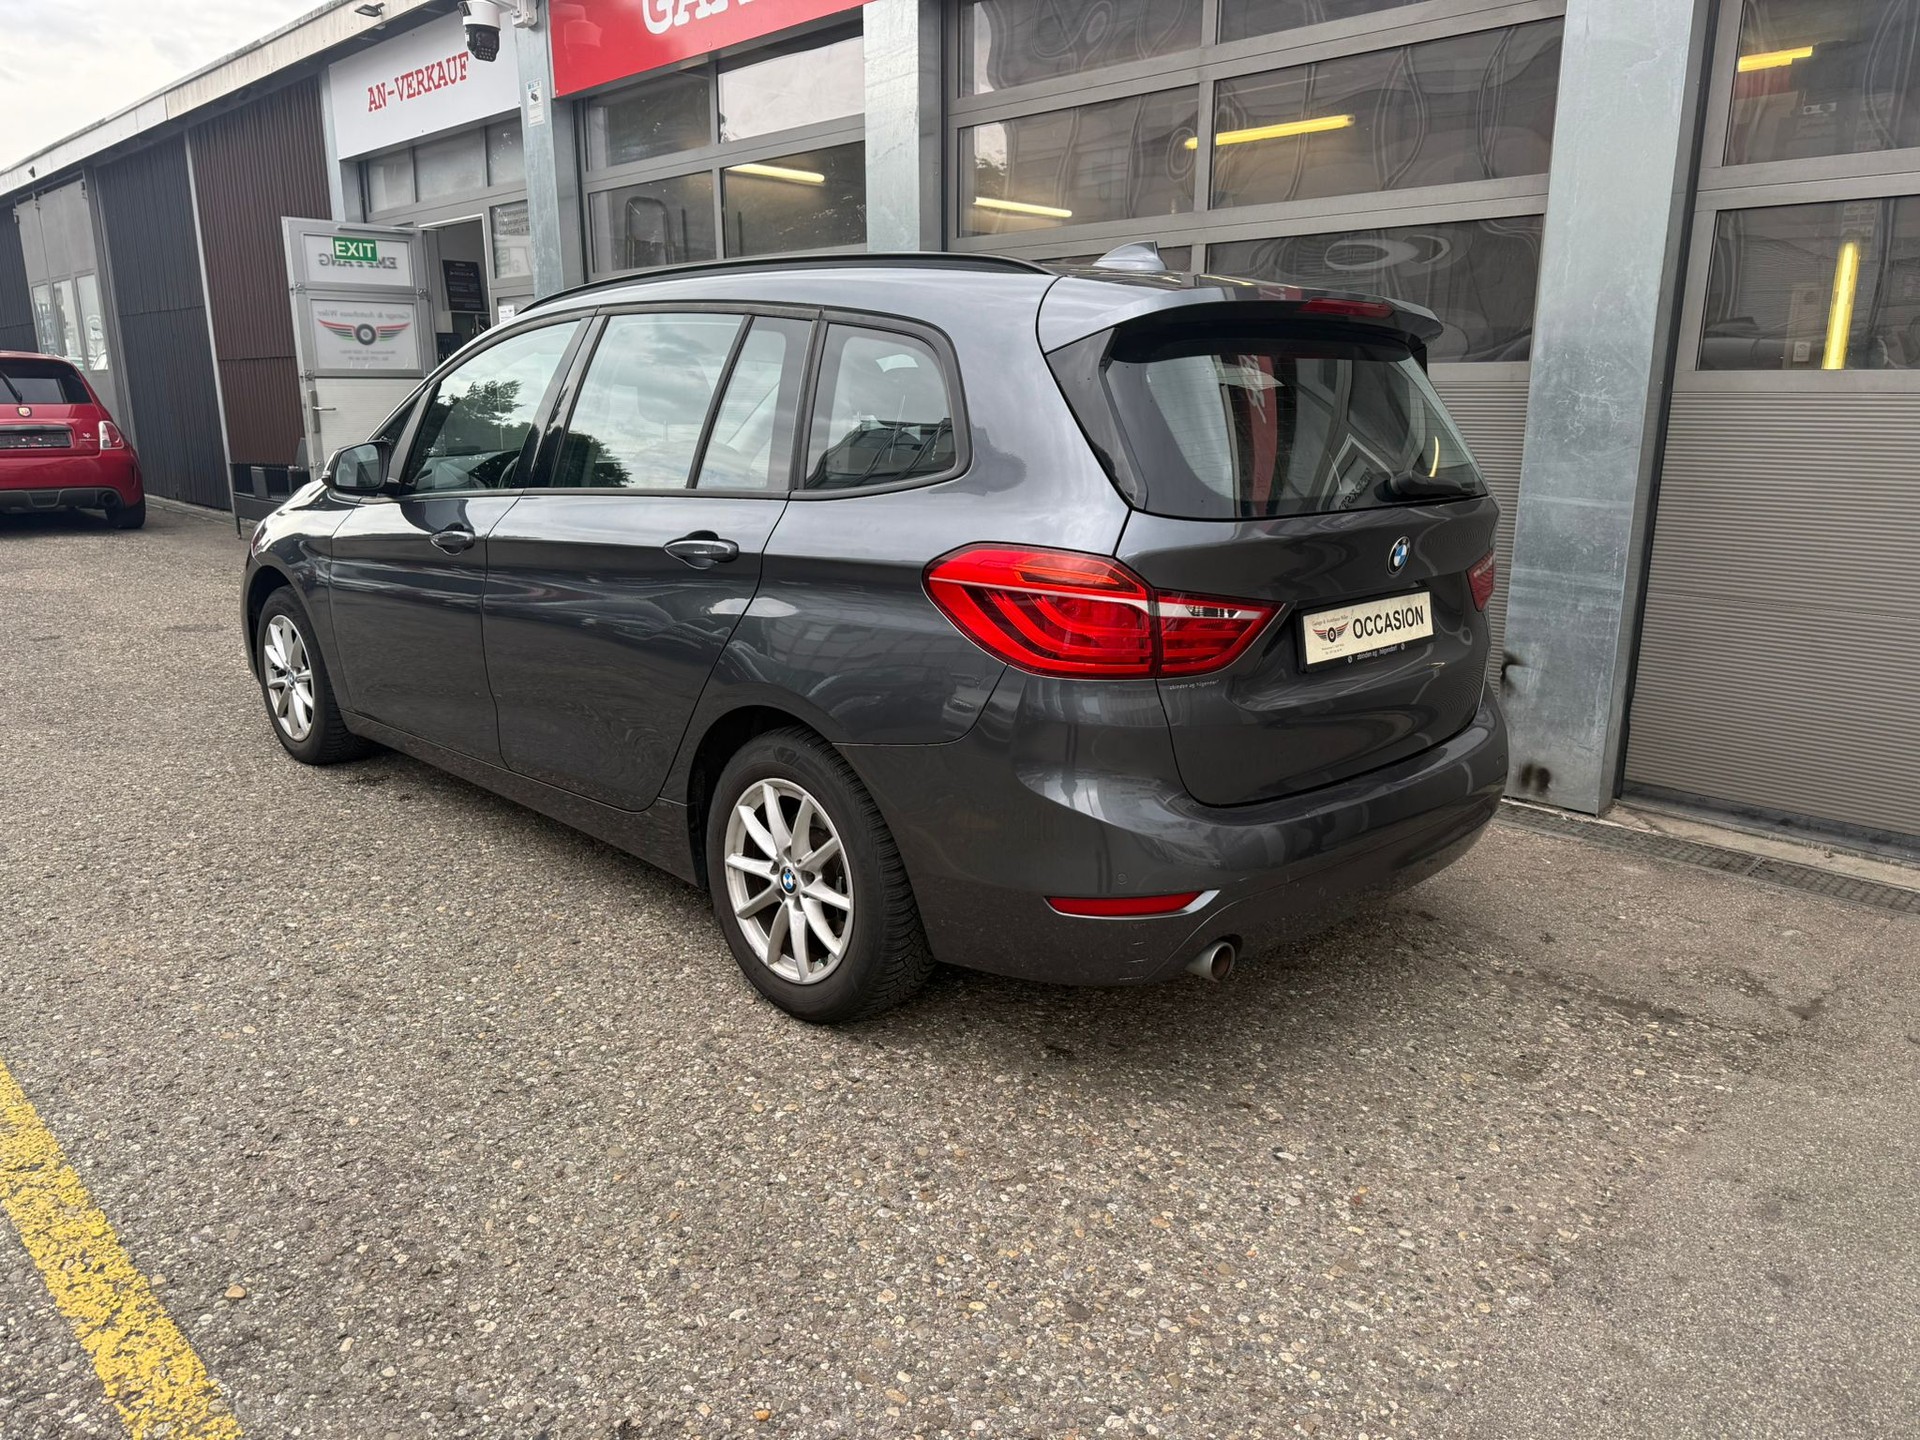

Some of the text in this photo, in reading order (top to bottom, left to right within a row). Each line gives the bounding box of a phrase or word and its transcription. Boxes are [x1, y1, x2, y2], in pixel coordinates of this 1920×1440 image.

[368, 51, 470, 113] AN-VERKAUF
[334, 240, 375, 258] EXIT
[1352, 605, 1424, 639] OCCASION
